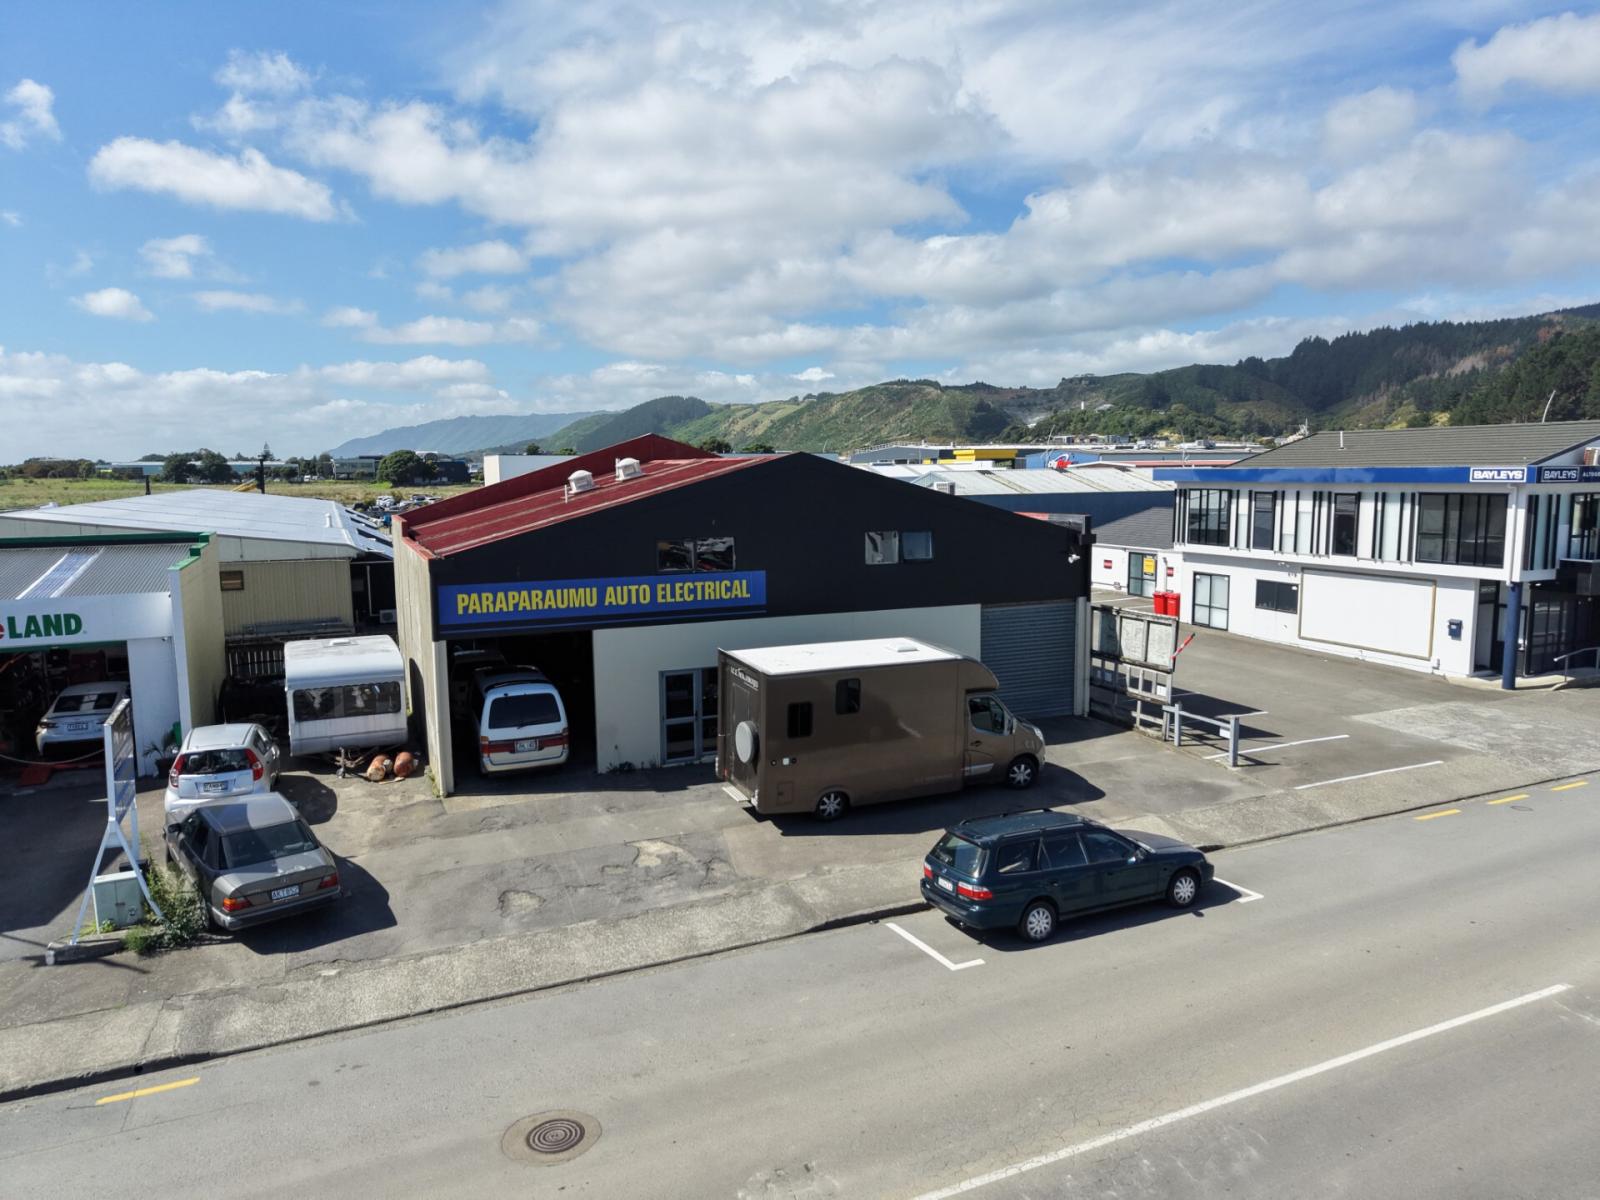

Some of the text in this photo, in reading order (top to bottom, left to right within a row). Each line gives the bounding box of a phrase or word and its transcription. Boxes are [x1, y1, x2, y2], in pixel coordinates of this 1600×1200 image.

[1473, 470, 1523, 480] BAYLEYS
[1543, 470, 1577, 480] BAYLEYS
[456, 579, 751, 615] PARAPARAUMU AUTO ELECTRICAL
